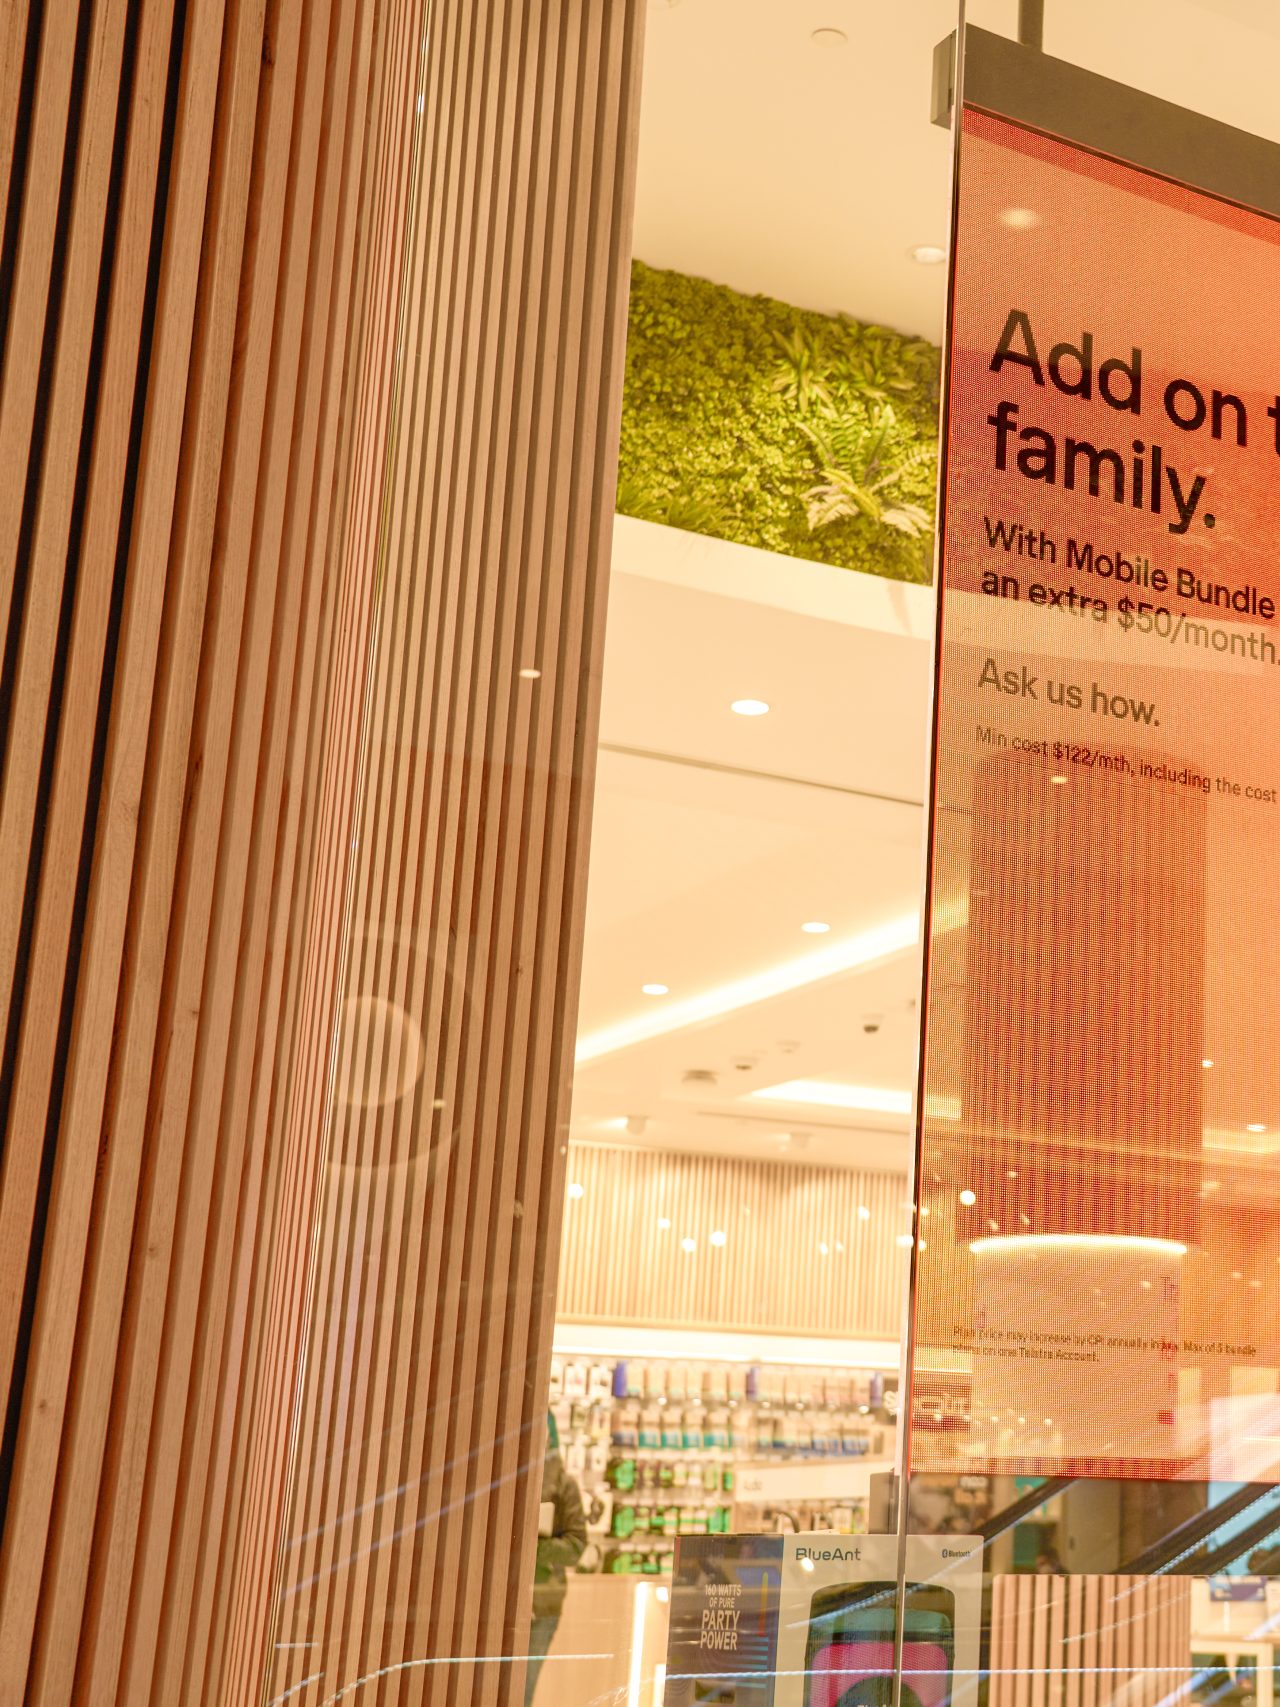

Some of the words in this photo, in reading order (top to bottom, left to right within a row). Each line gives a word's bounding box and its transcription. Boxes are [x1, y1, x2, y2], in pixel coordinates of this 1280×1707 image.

[988, 308, 1142, 415] Add
[1163, 378, 1248, 447] on
[987, 401, 1217, 534] family.
[983, 516, 1057, 563] With
[1067, 538, 1169, 592] Mobile
[1177, 568, 1275, 619] Bundle
[981, 570, 1020, 600] an
[1028, 580, 1108, 623] extra
[977, 657, 1039, 700] Ask
[1047, 679, 1083, 709] us
[1091, 681, 1161, 727] how.
[975, 724, 1008, 747] Min
[1012, 733, 1049, 757] cost
[1052, 741, 1136, 778] $122/mth,
[1139, 758, 1211, 793] including
[1215, 776, 1241, 797] the
[1245, 782, 1278, 804] cost
[953, 1326, 975, 1338] Plan
[979, 1329, 1003, 1340] price
[1006, 1331, 1027, 1342] may
[1029, 1330, 1071, 1344] increase
[1074, 1334, 1086, 1346] by
[1107, 1336, 1147, 1350] annually
[1183, 1340, 1203, 1352] Max
[1205, 1342, 1216, 1353] of
[1225, 1342, 1257, 1357] bundle
[982, 1346, 996, 1356] on
[998, 1347, 1017, 1357] one
[1019, 1347, 1053, 1358] Telstra
[1055, 1348, 1100, 1362] Account.
[795, 1547, 861, 1561] BlueAnt
[705, 1584, 717, 1596] 160
[718, 1584, 742, 1596] WATTS
[709, 1597, 718, 1608] OF
[719, 1597, 735, 1608] PURE
[702, 1609, 741, 1631] PARTY
[700, 1631, 738, 1650] POWER
